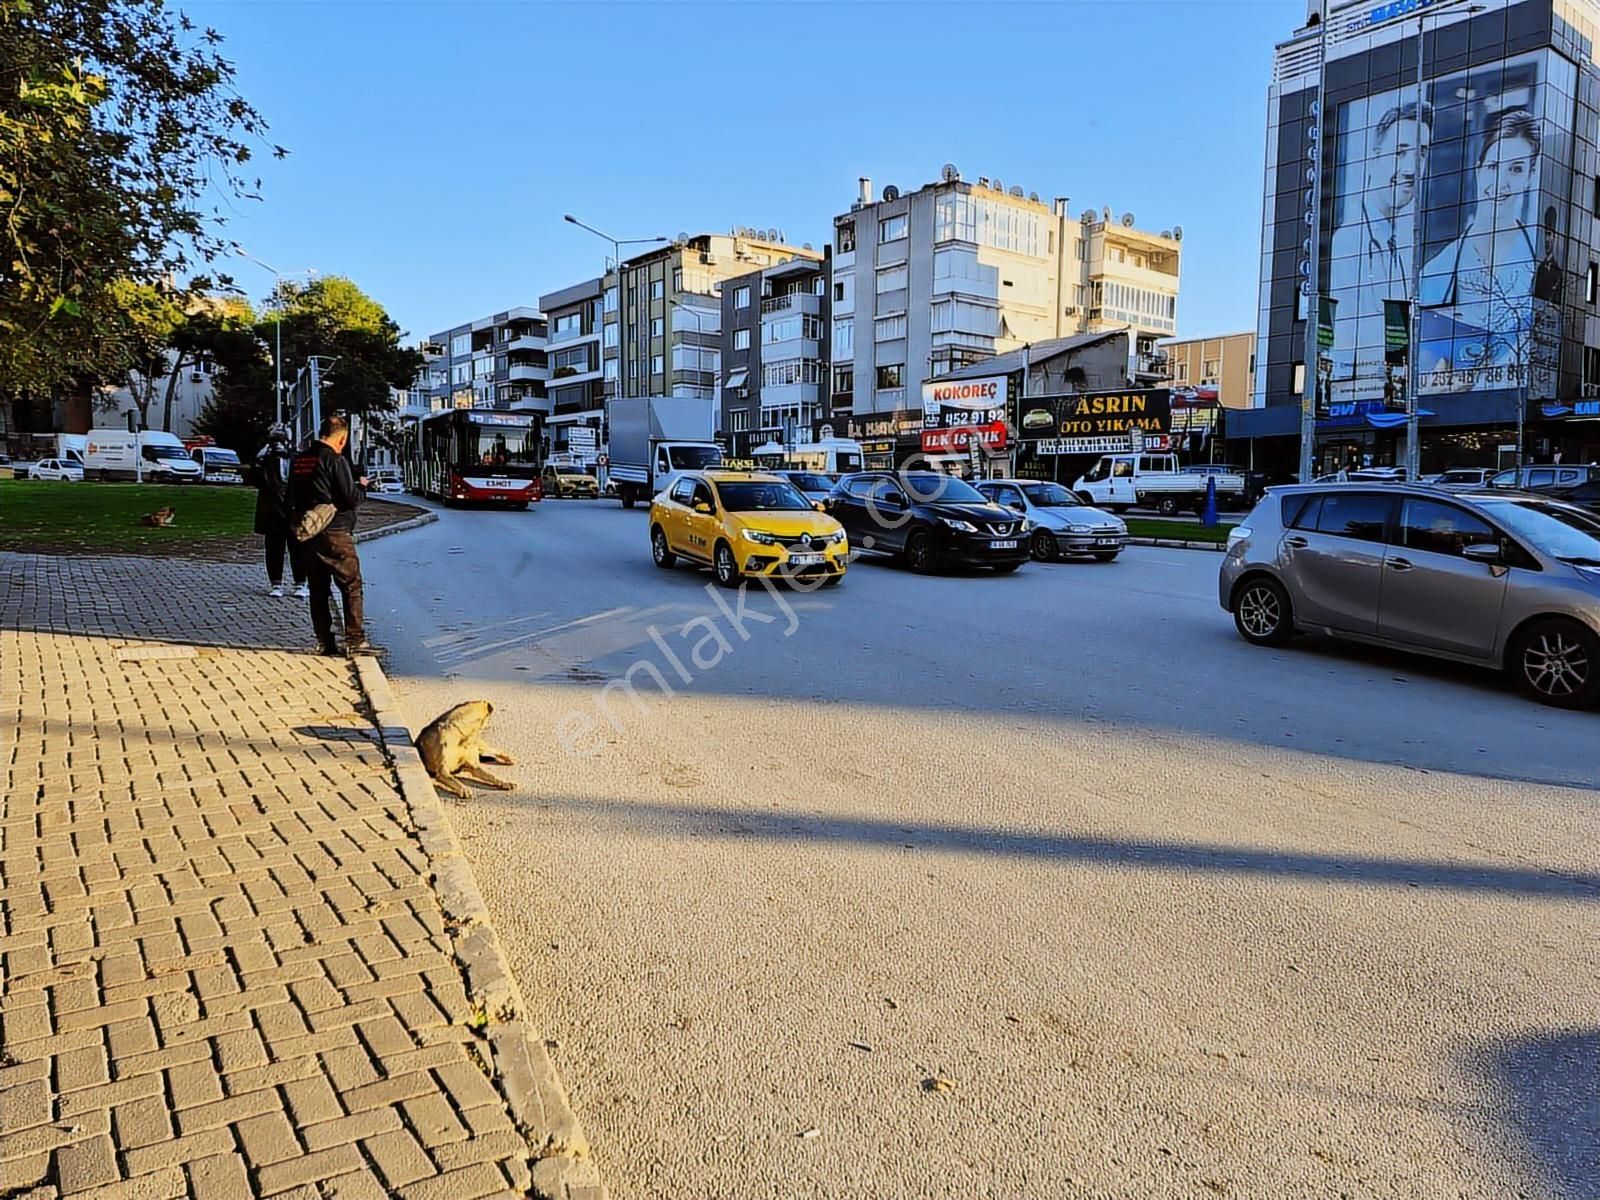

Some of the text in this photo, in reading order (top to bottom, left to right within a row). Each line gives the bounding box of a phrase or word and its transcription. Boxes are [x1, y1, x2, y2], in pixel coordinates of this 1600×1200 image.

[934, 383, 997, 401] KOKOREÇ
[1075, 395, 1146, 415] ASRIN
[946, 409, 1004, 425] 452 91 92
[1061, 420, 1092, 433] OTO
[1096, 418, 1162, 432] YIKAMA
